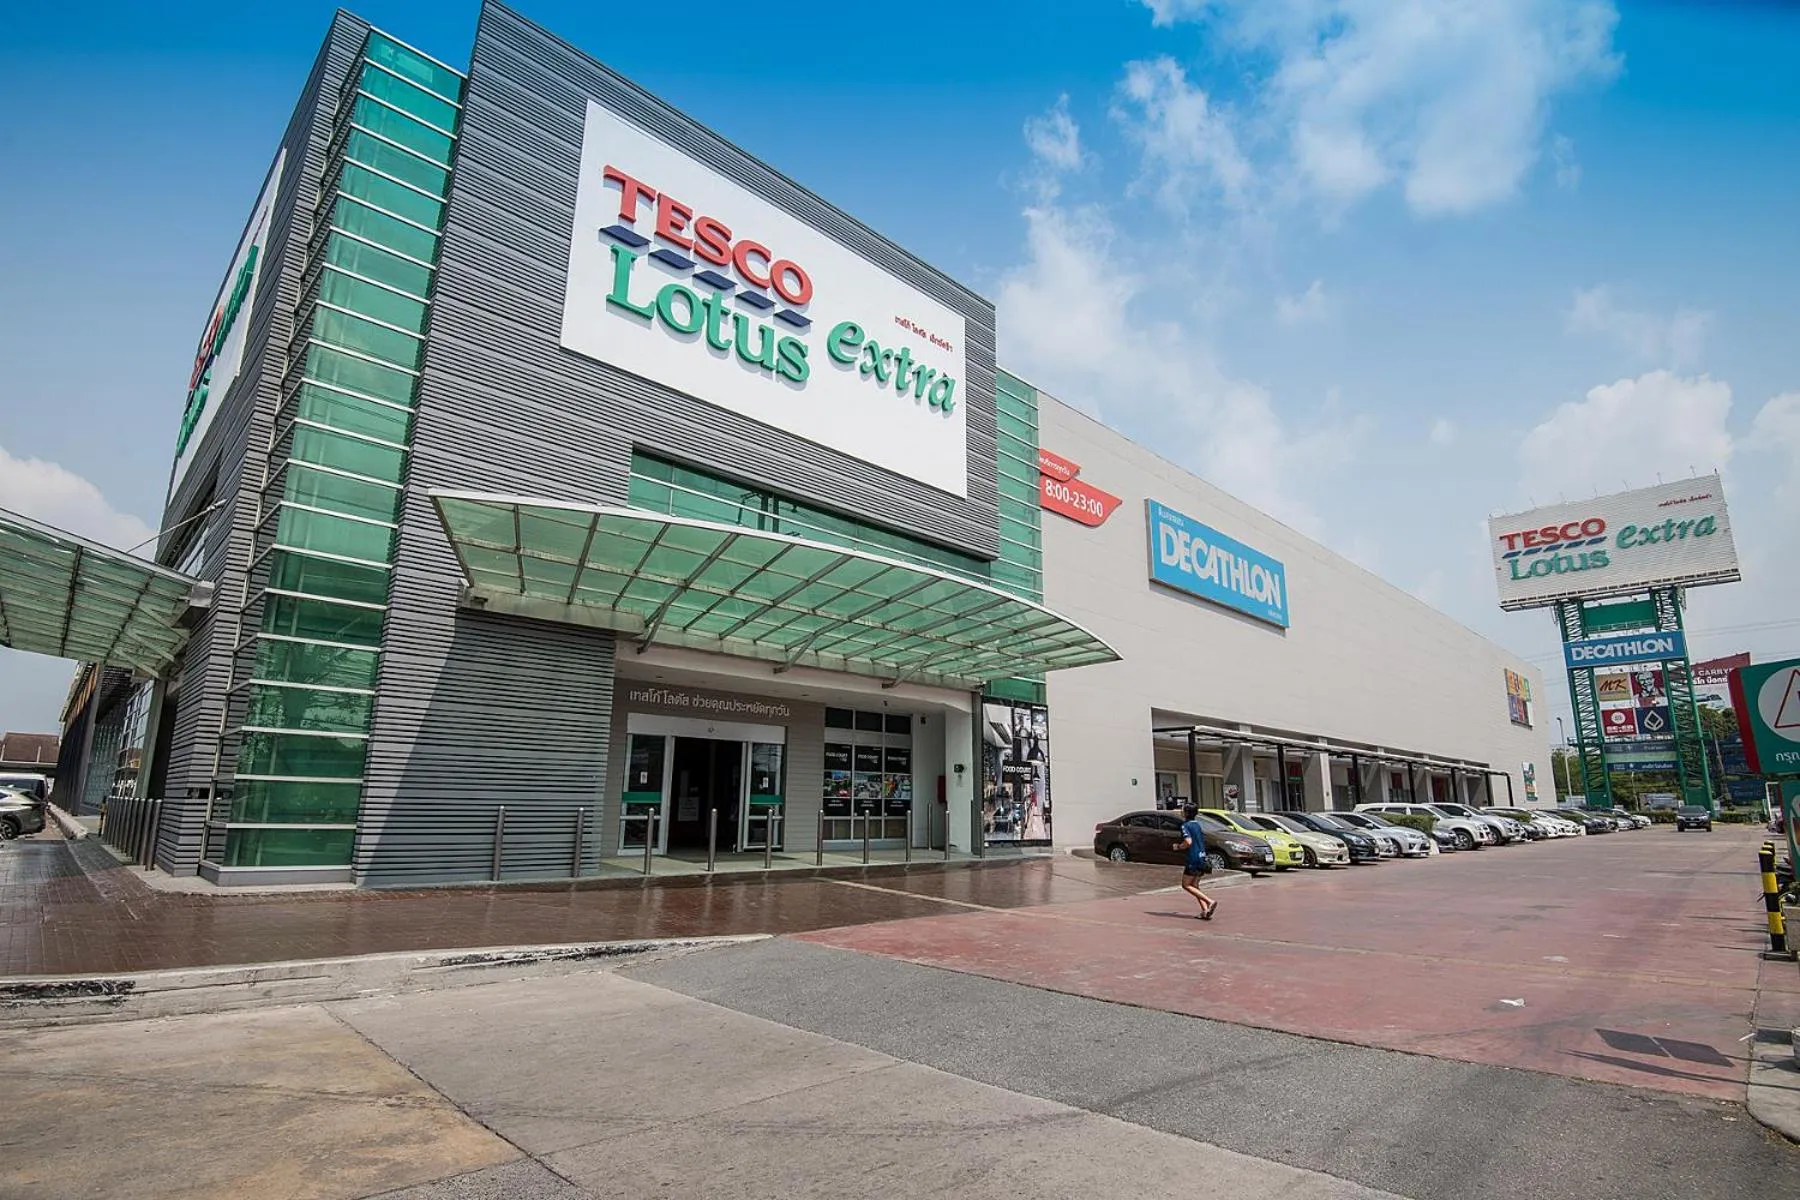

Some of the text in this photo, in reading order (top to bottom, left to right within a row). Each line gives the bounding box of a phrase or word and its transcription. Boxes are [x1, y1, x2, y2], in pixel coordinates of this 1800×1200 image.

[603, 164, 813, 305] TESCO
[606, 243, 956, 412] Lotus extra
[1045, 479, 1104, 518] 8:00-23:00
[1500, 517, 1608, 551] TESCO
[1616, 514, 1718, 549] extra
[1160, 522, 1281, 609] DECATHLON
[1508, 548, 1611, 581] Lotus
[1571, 638, 1674, 660] DECATHLON
[1600, 679, 1628, 692] MK
